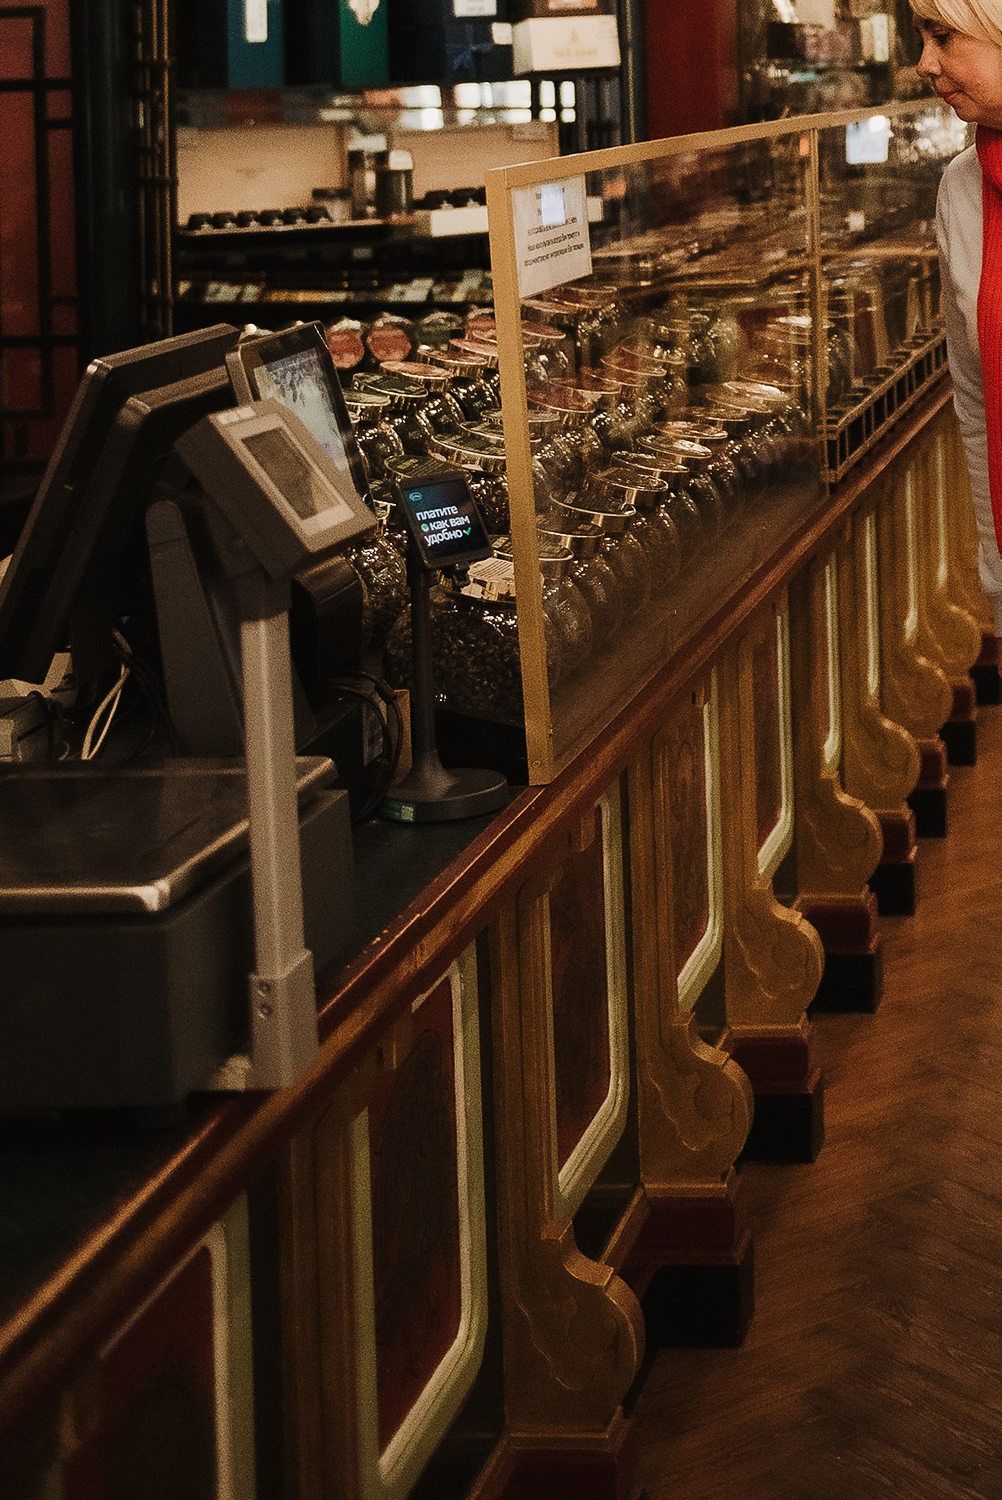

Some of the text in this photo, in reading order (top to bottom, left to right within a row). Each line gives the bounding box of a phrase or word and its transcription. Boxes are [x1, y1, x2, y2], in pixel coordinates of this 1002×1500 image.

[416, 505, 458, 521] платите
[429, 516, 470, 531] как вам
[424, 528, 463, 547] удобно
